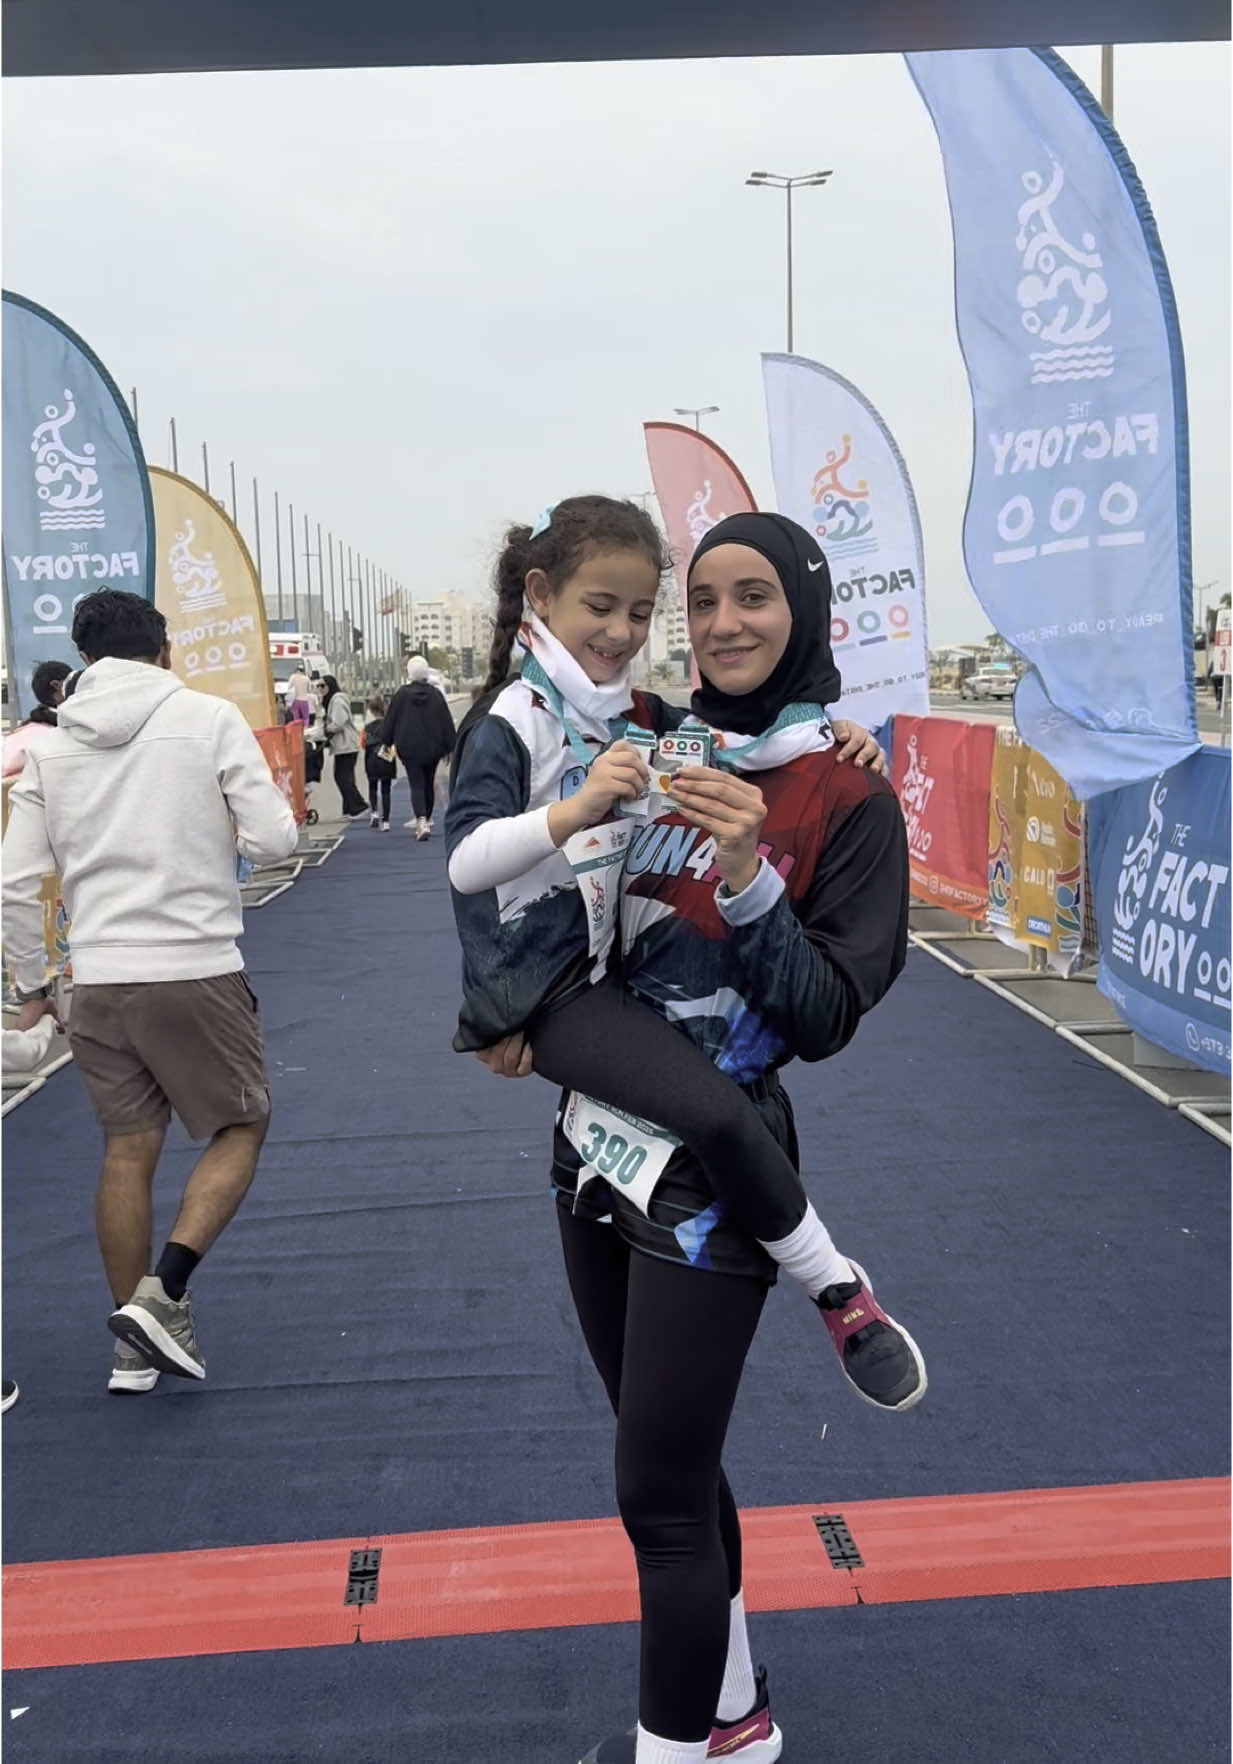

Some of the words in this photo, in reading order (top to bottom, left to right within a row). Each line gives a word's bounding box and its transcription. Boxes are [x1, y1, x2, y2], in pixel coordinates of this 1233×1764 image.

[1170, 823, 1191, 847] THE
[1148, 850, 1229, 929] FACT
[1139, 918, 1198, 994] ORY
[580, 1121, 648, 1185] 390
